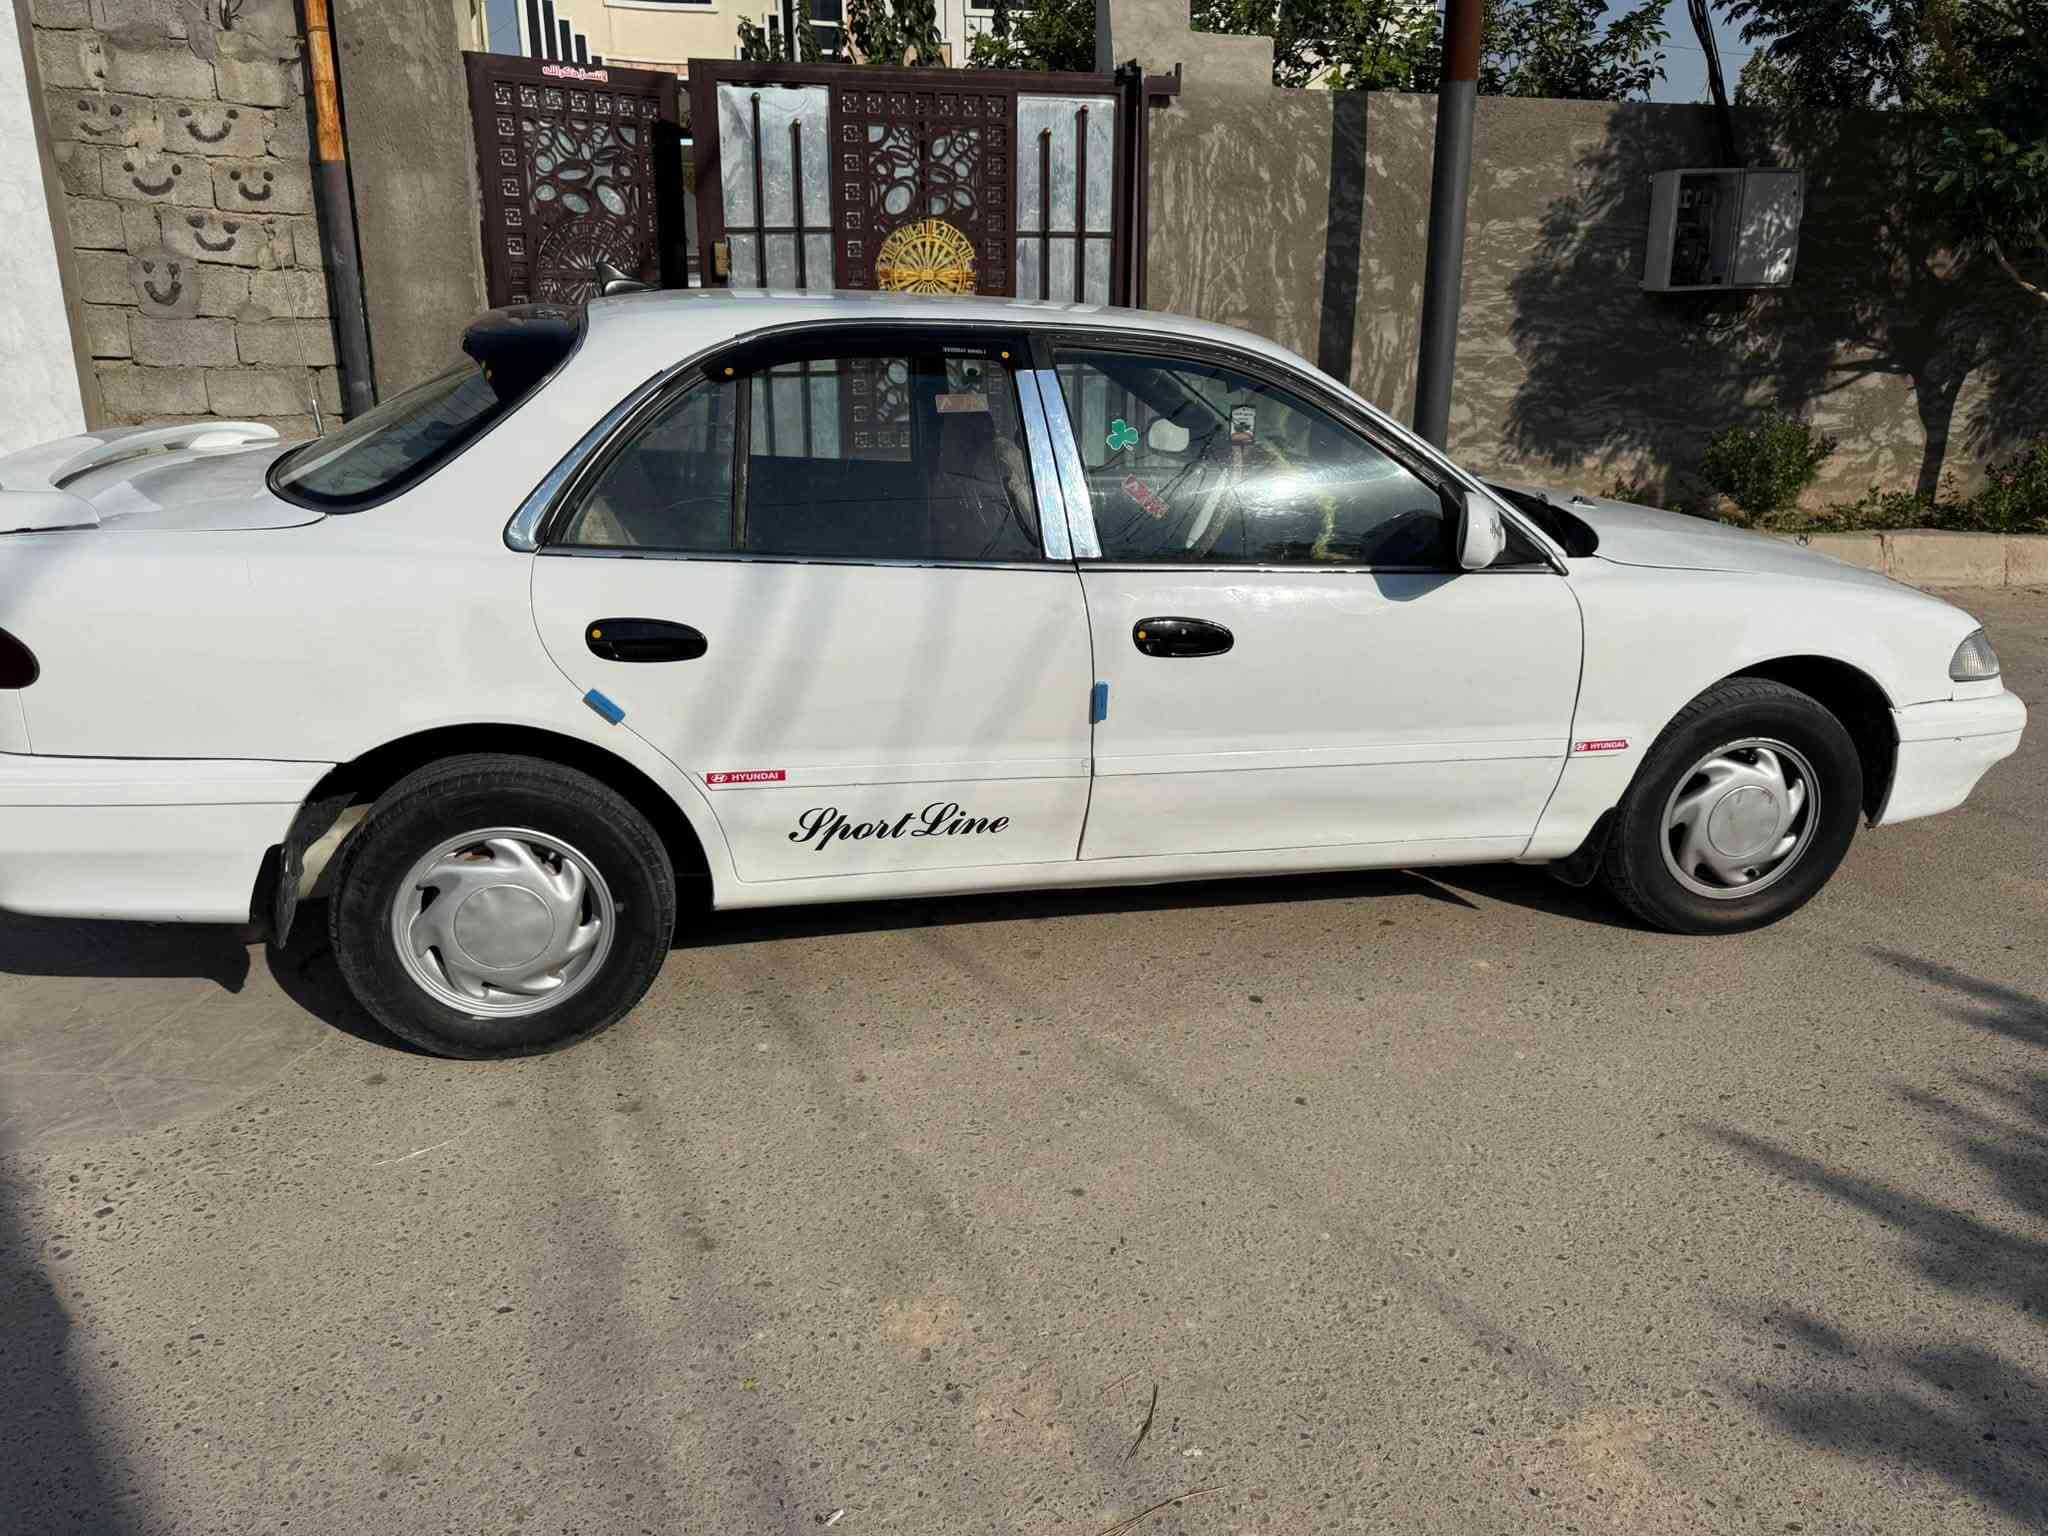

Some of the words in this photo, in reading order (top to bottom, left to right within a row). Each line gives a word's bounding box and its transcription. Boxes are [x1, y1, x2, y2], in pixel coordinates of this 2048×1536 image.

[1589, 741, 1625, 750] HYUNDAI
[731, 772, 779, 781] HYUNDAI
[788, 807, 916, 851] Sport
[911, 802, 1010, 837] Line
